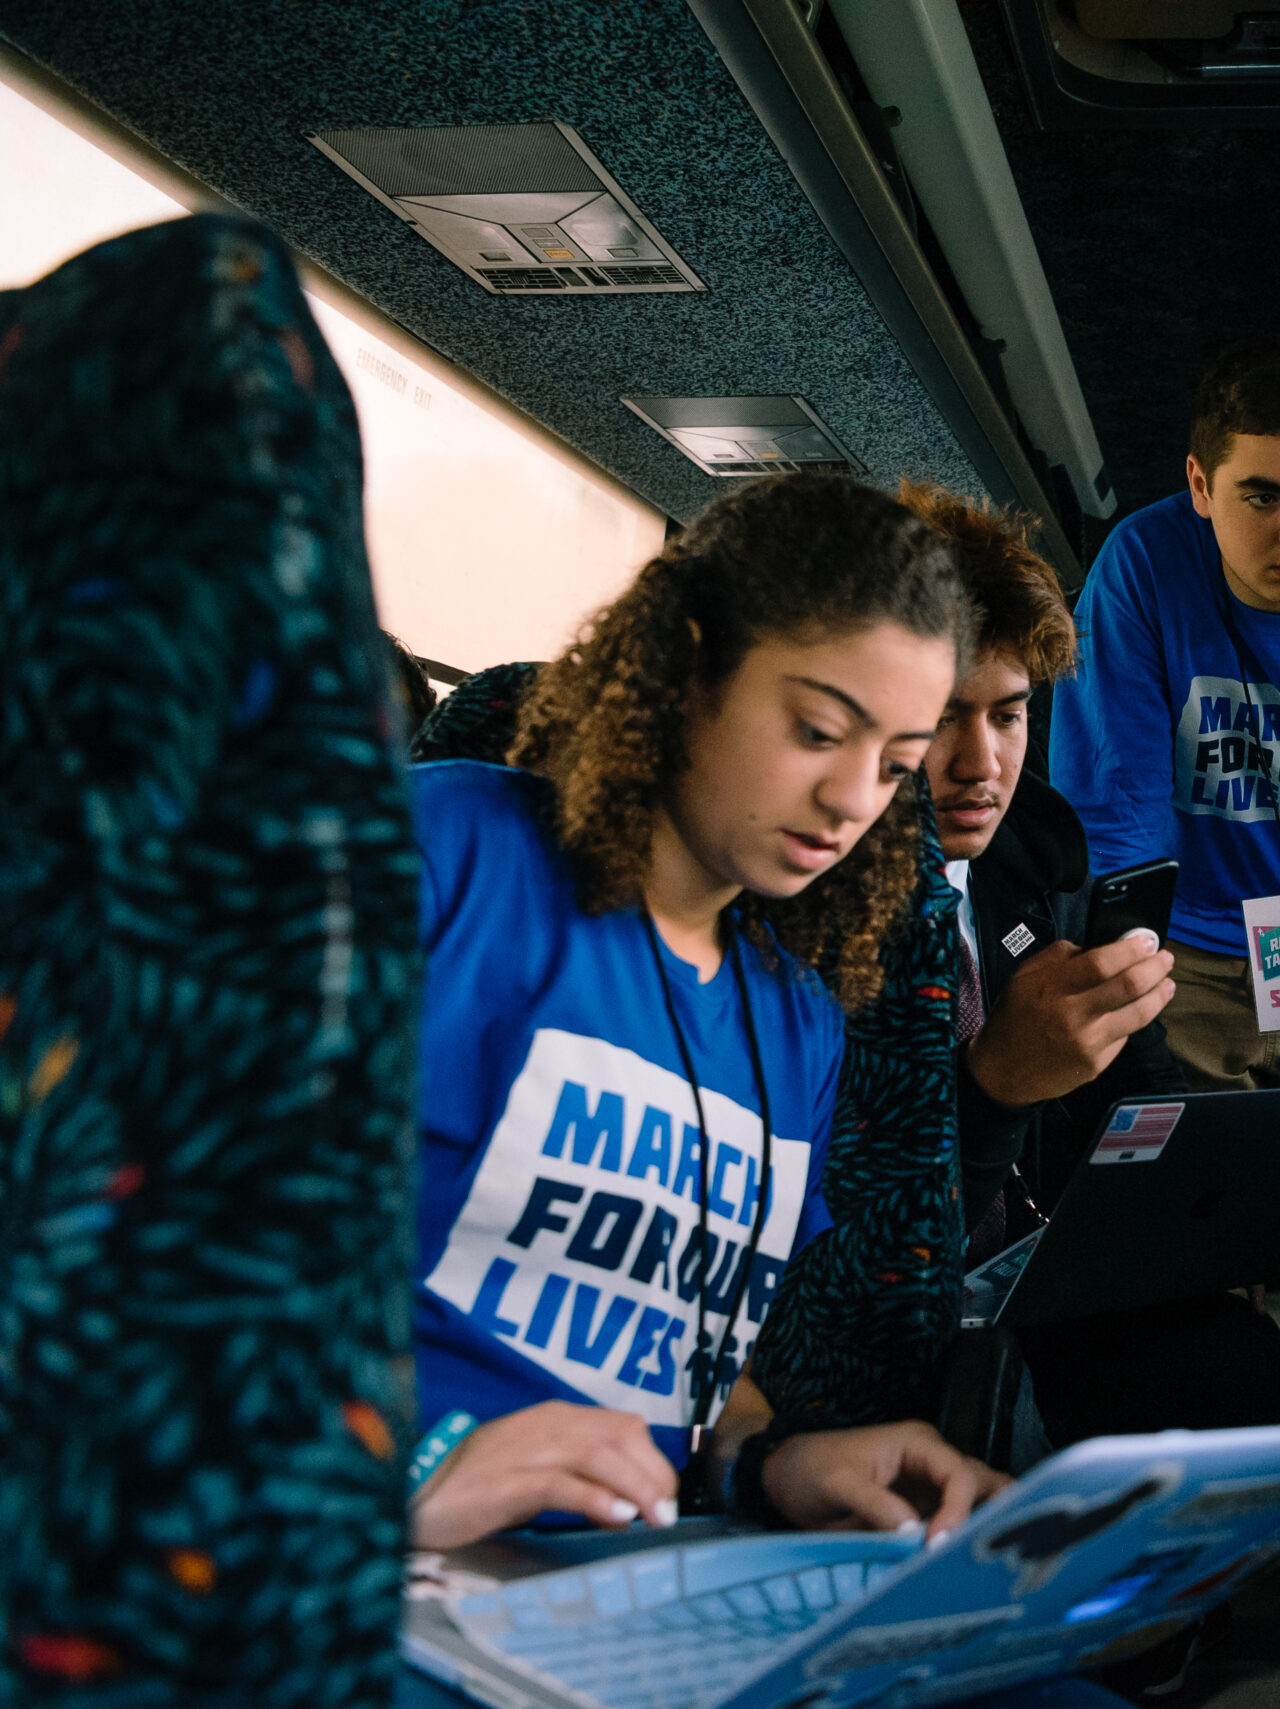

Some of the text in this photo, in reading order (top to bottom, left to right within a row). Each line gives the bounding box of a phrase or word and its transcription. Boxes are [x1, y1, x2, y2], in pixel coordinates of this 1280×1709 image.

[356, 347, 432, 411] EMERGENCY EXIT
[1195, 737, 1275, 779] FOR
[1004, 927, 1023, 945] MARCH
[1008, 930, 1030, 950] FOR OUR
[540, 1079, 775, 1228] MARCH
[506, 1176, 680, 1291] FOR
[466, 1256, 686, 1397] LIVES
